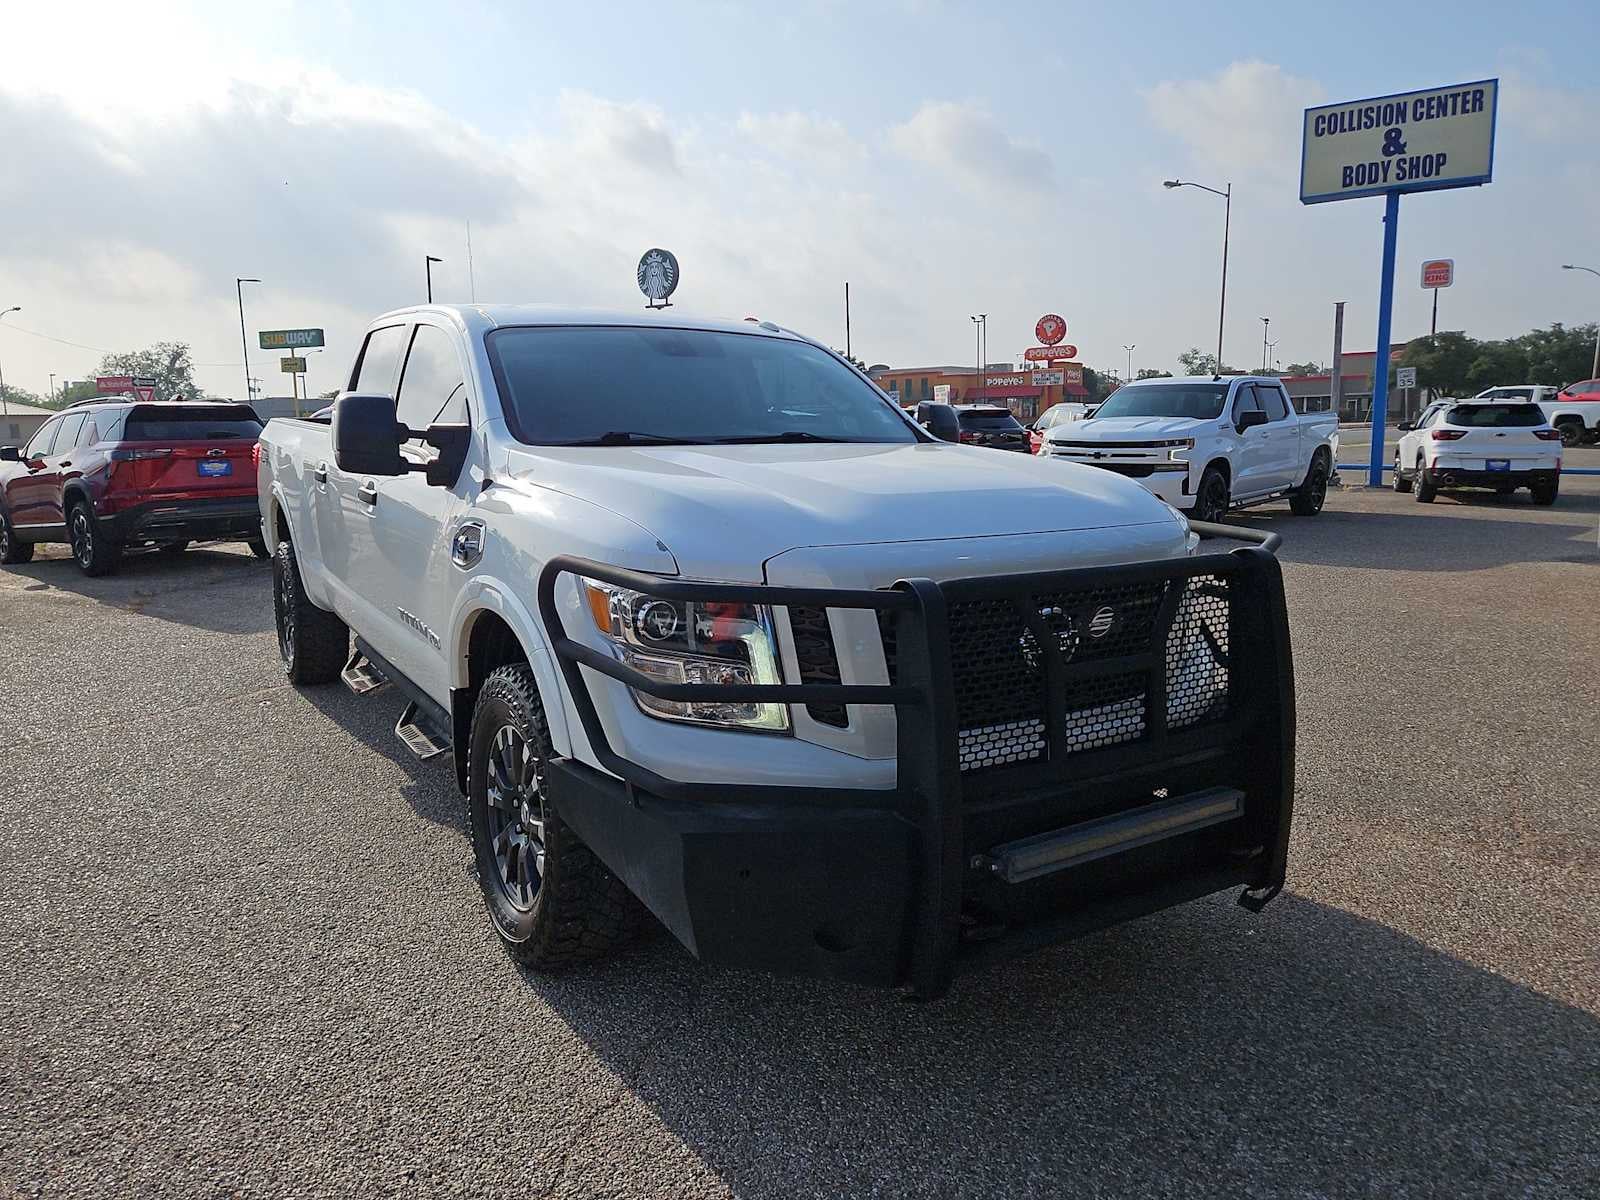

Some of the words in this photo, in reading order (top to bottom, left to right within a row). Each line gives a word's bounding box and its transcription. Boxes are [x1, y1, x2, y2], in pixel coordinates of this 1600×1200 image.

[1314, 101, 1408, 137] COLLISION
[1413, 90, 1484, 120] CENTER
[1382, 128, 1407, 156] &
[1342, 161, 1391, 187] BODY
[1396, 153, 1446, 180] SHOP
[1425, 274, 1449, 282] KING
[263, 331, 313, 345] SUBWAY
[1399, 379, 1414, 387] 35
